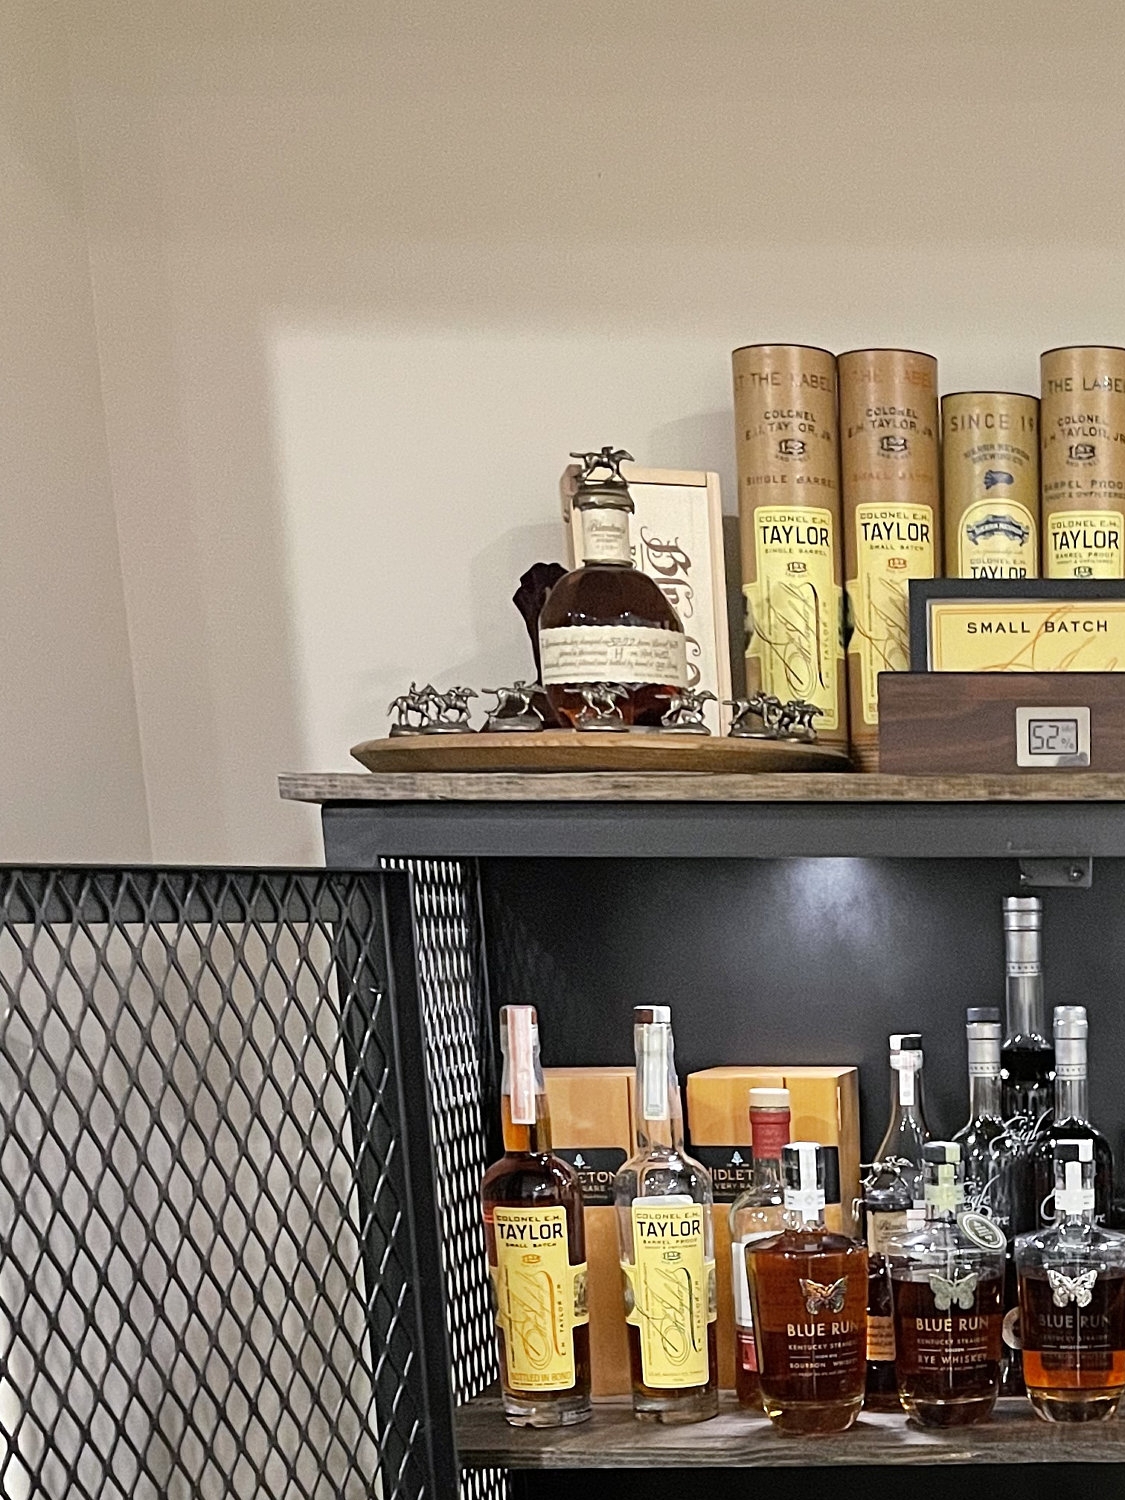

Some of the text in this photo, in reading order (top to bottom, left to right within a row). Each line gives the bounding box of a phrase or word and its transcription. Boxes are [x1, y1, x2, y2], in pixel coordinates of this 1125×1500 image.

[1048, 378, 1073, 394] THE
[950, 413, 1010, 432] SINCE
[759, 515, 809, 524] COLONEL
[860, 512, 909, 521] COLONEL
[861, 522, 931, 544] TAYLOR
[1051, 520, 1096, 530] COLONEL
[760, 525, 830, 548] TAYLOR
[1052, 529, 1120, 551] TAYLOR
[970, 566, 1027, 580] TAYLOR
[966, 620, 1108, 634] SMALL BATCH
[1032, 724, 1060, 750] 52
[497, 1215, 539, 1223] COLONEL
[497, 1223, 564, 1241] TAYLOR
[637, 1220, 701, 1238] TAYLOR
[787, 1320, 859, 1338] BLUE RUN
[916, 1316, 989, 1332] BLUE RUN
[1039, 1315, 1111, 1329] BLUE RUN
[788, 1343, 828, 1351] KENTUCKY
[917, 1353, 988, 1364] RYE WHISKEY
